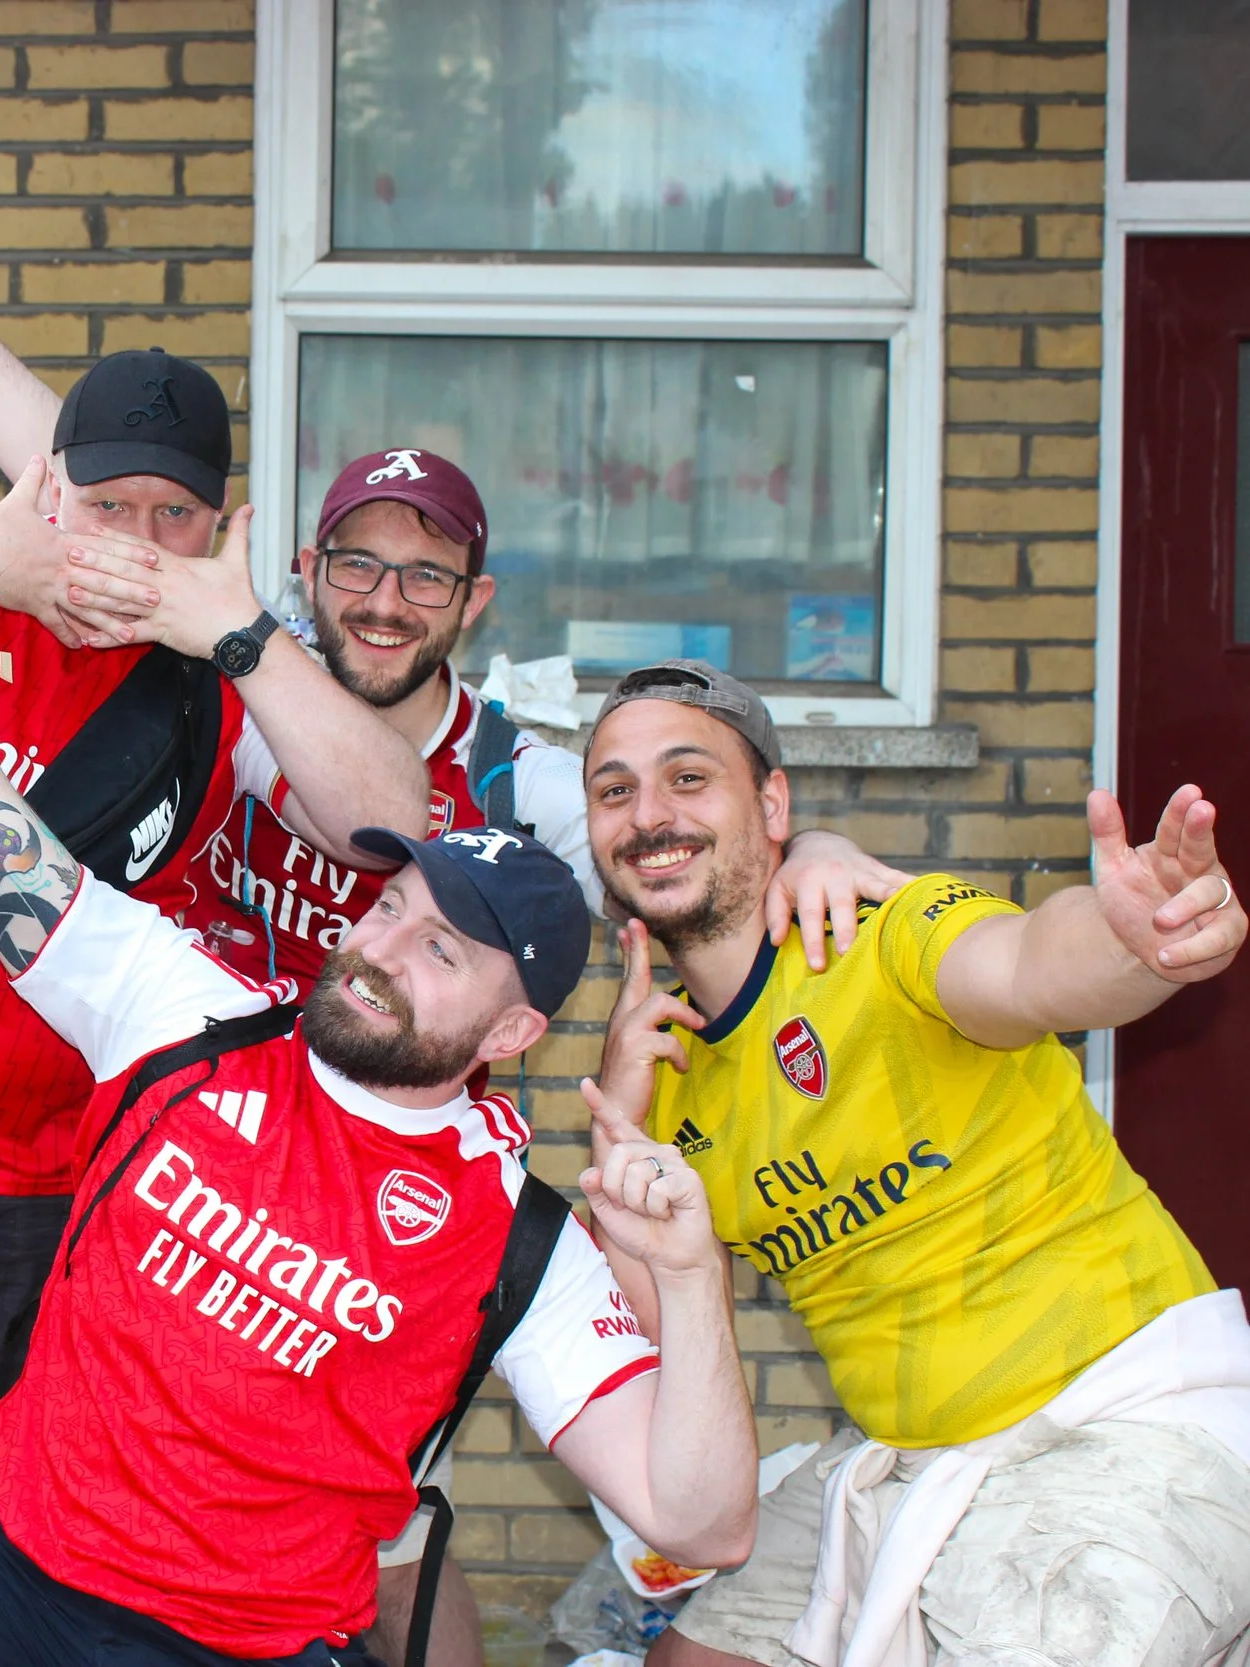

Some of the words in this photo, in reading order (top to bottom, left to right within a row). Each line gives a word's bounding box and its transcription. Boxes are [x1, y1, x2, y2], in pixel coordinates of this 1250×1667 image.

[365, 450, 428, 485] A
[282, 836, 358, 905] Fly
[443, 828, 523, 865] A
[210, 833, 354, 950] Emira
[779, 1028, 810, 1060] Arsenal
[680, 1137, 713, 1158] idas
[392, 1179, 442, 1211] Arsenal
[753, 1149, 829, 1209] Fly
[134, 1139, 403, 1343] Emirates
[136, 1228, 209, 1297] FLY
[195, 1269, 338, 1378] BETTER
